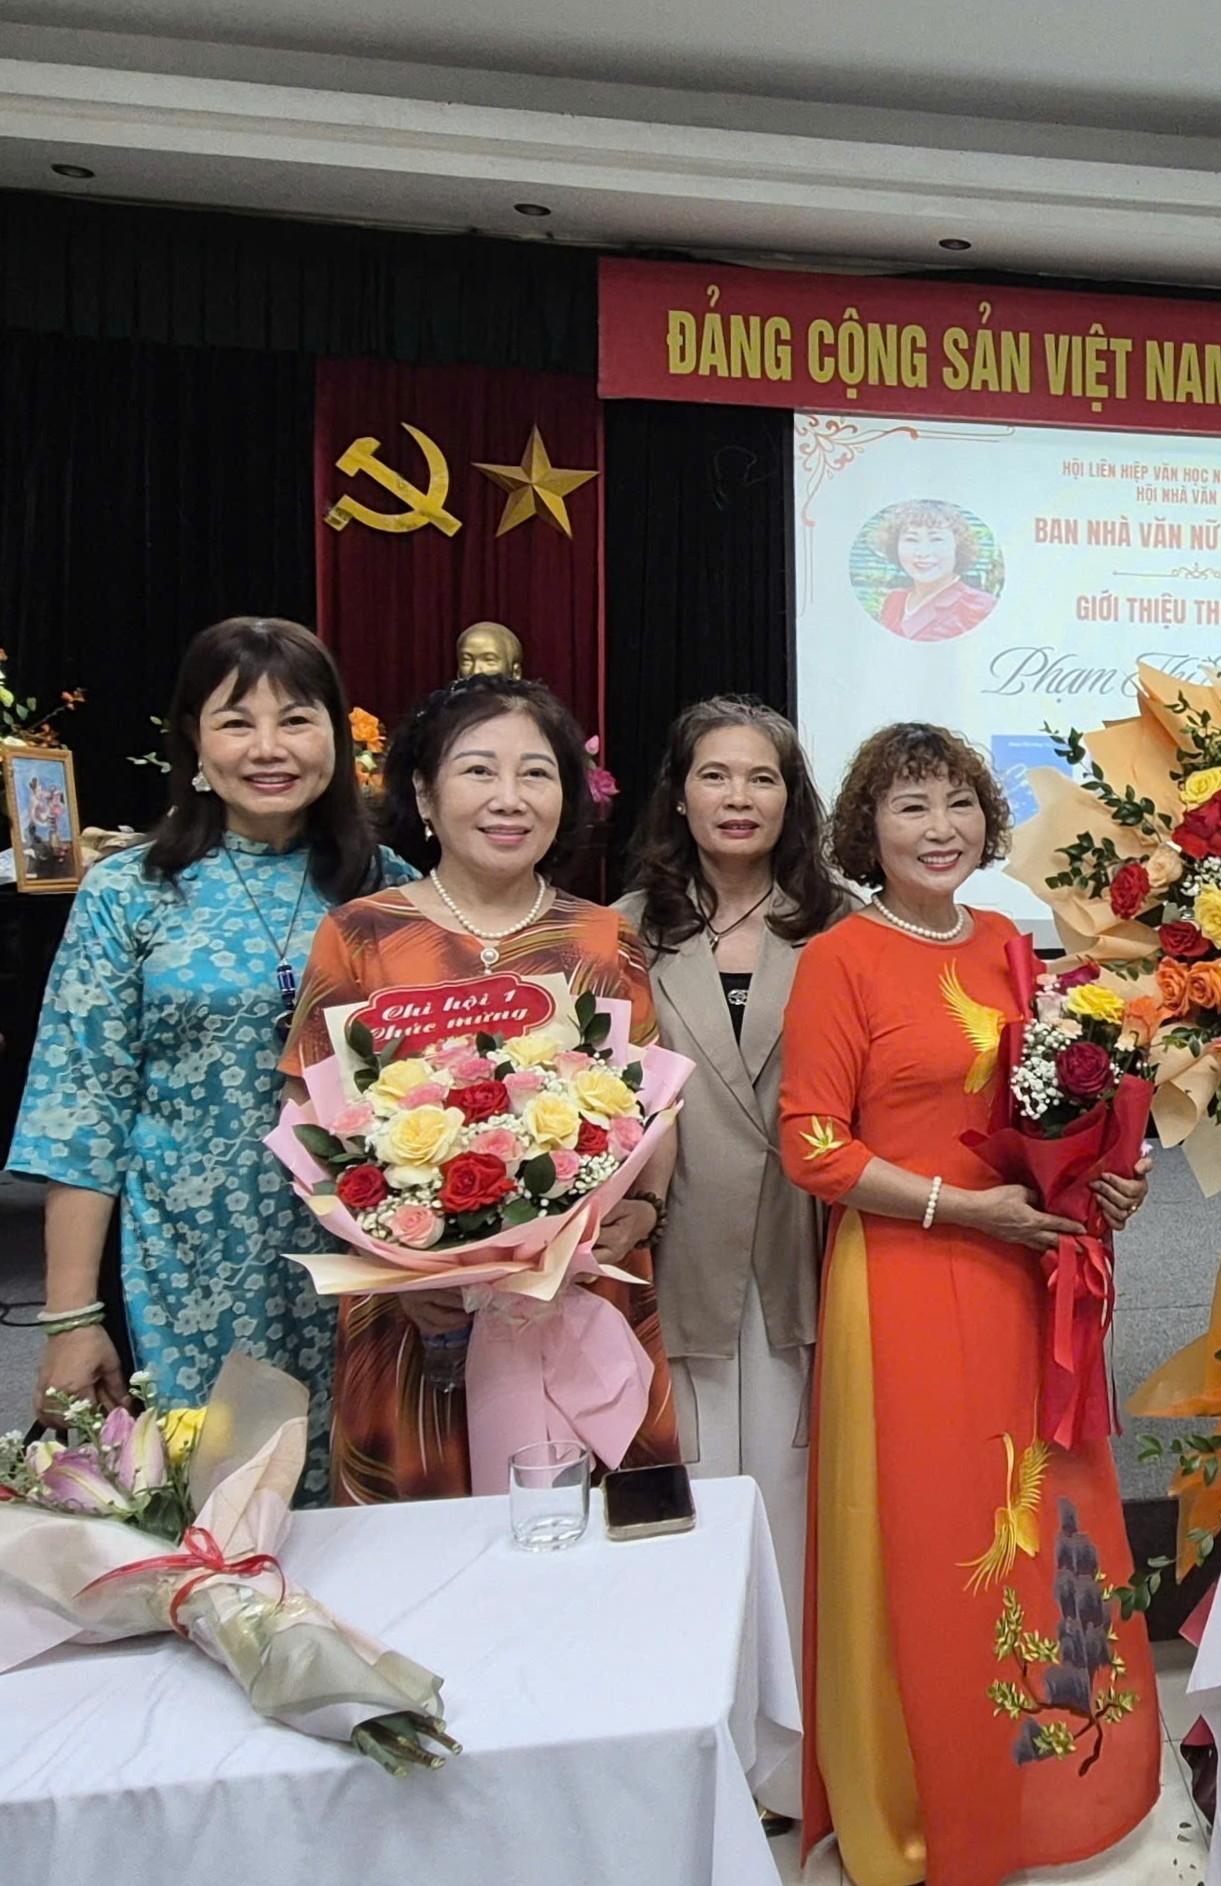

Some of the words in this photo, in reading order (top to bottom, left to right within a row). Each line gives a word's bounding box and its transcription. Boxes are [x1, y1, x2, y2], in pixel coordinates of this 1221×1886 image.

[666, 284, 792, 383] ĐẢNG
[807, 307, 928, 399] CỘNG
[942, 301, 1030, 395] SẢN
[1044, 323, 1132, 412] VIỆT
[1063, 458, 1084, 480] HỘI
[1089, 458, 1116, 478] LIÊN
[1120, 461, 1149, 483] HIỆP
[1154, 463, 1178, 482] VĂN
[1183, 467, 1208, 486] HỌC
[1136, 483, 1157, 505] HỘI
[1162, 485, 1188, 504] NHÀ
[1192, 486, 1217, 505] VĂN
[1034, 517, 1079, 545] BAN
[1086, 515, 1131, 547] NHÀ
[1139, 516, 1182, 549] VĂN
[1190, 519, 1221, 551] NỮ
[1076, 590, 1119, 622] GIỚI
[1126, 592, 1187, 629] THIỆU
[980, 646, 1118, 703] Phạm
[382, 1002, 433, 1021] Chi
[442, 992, 491, 1011] hội
